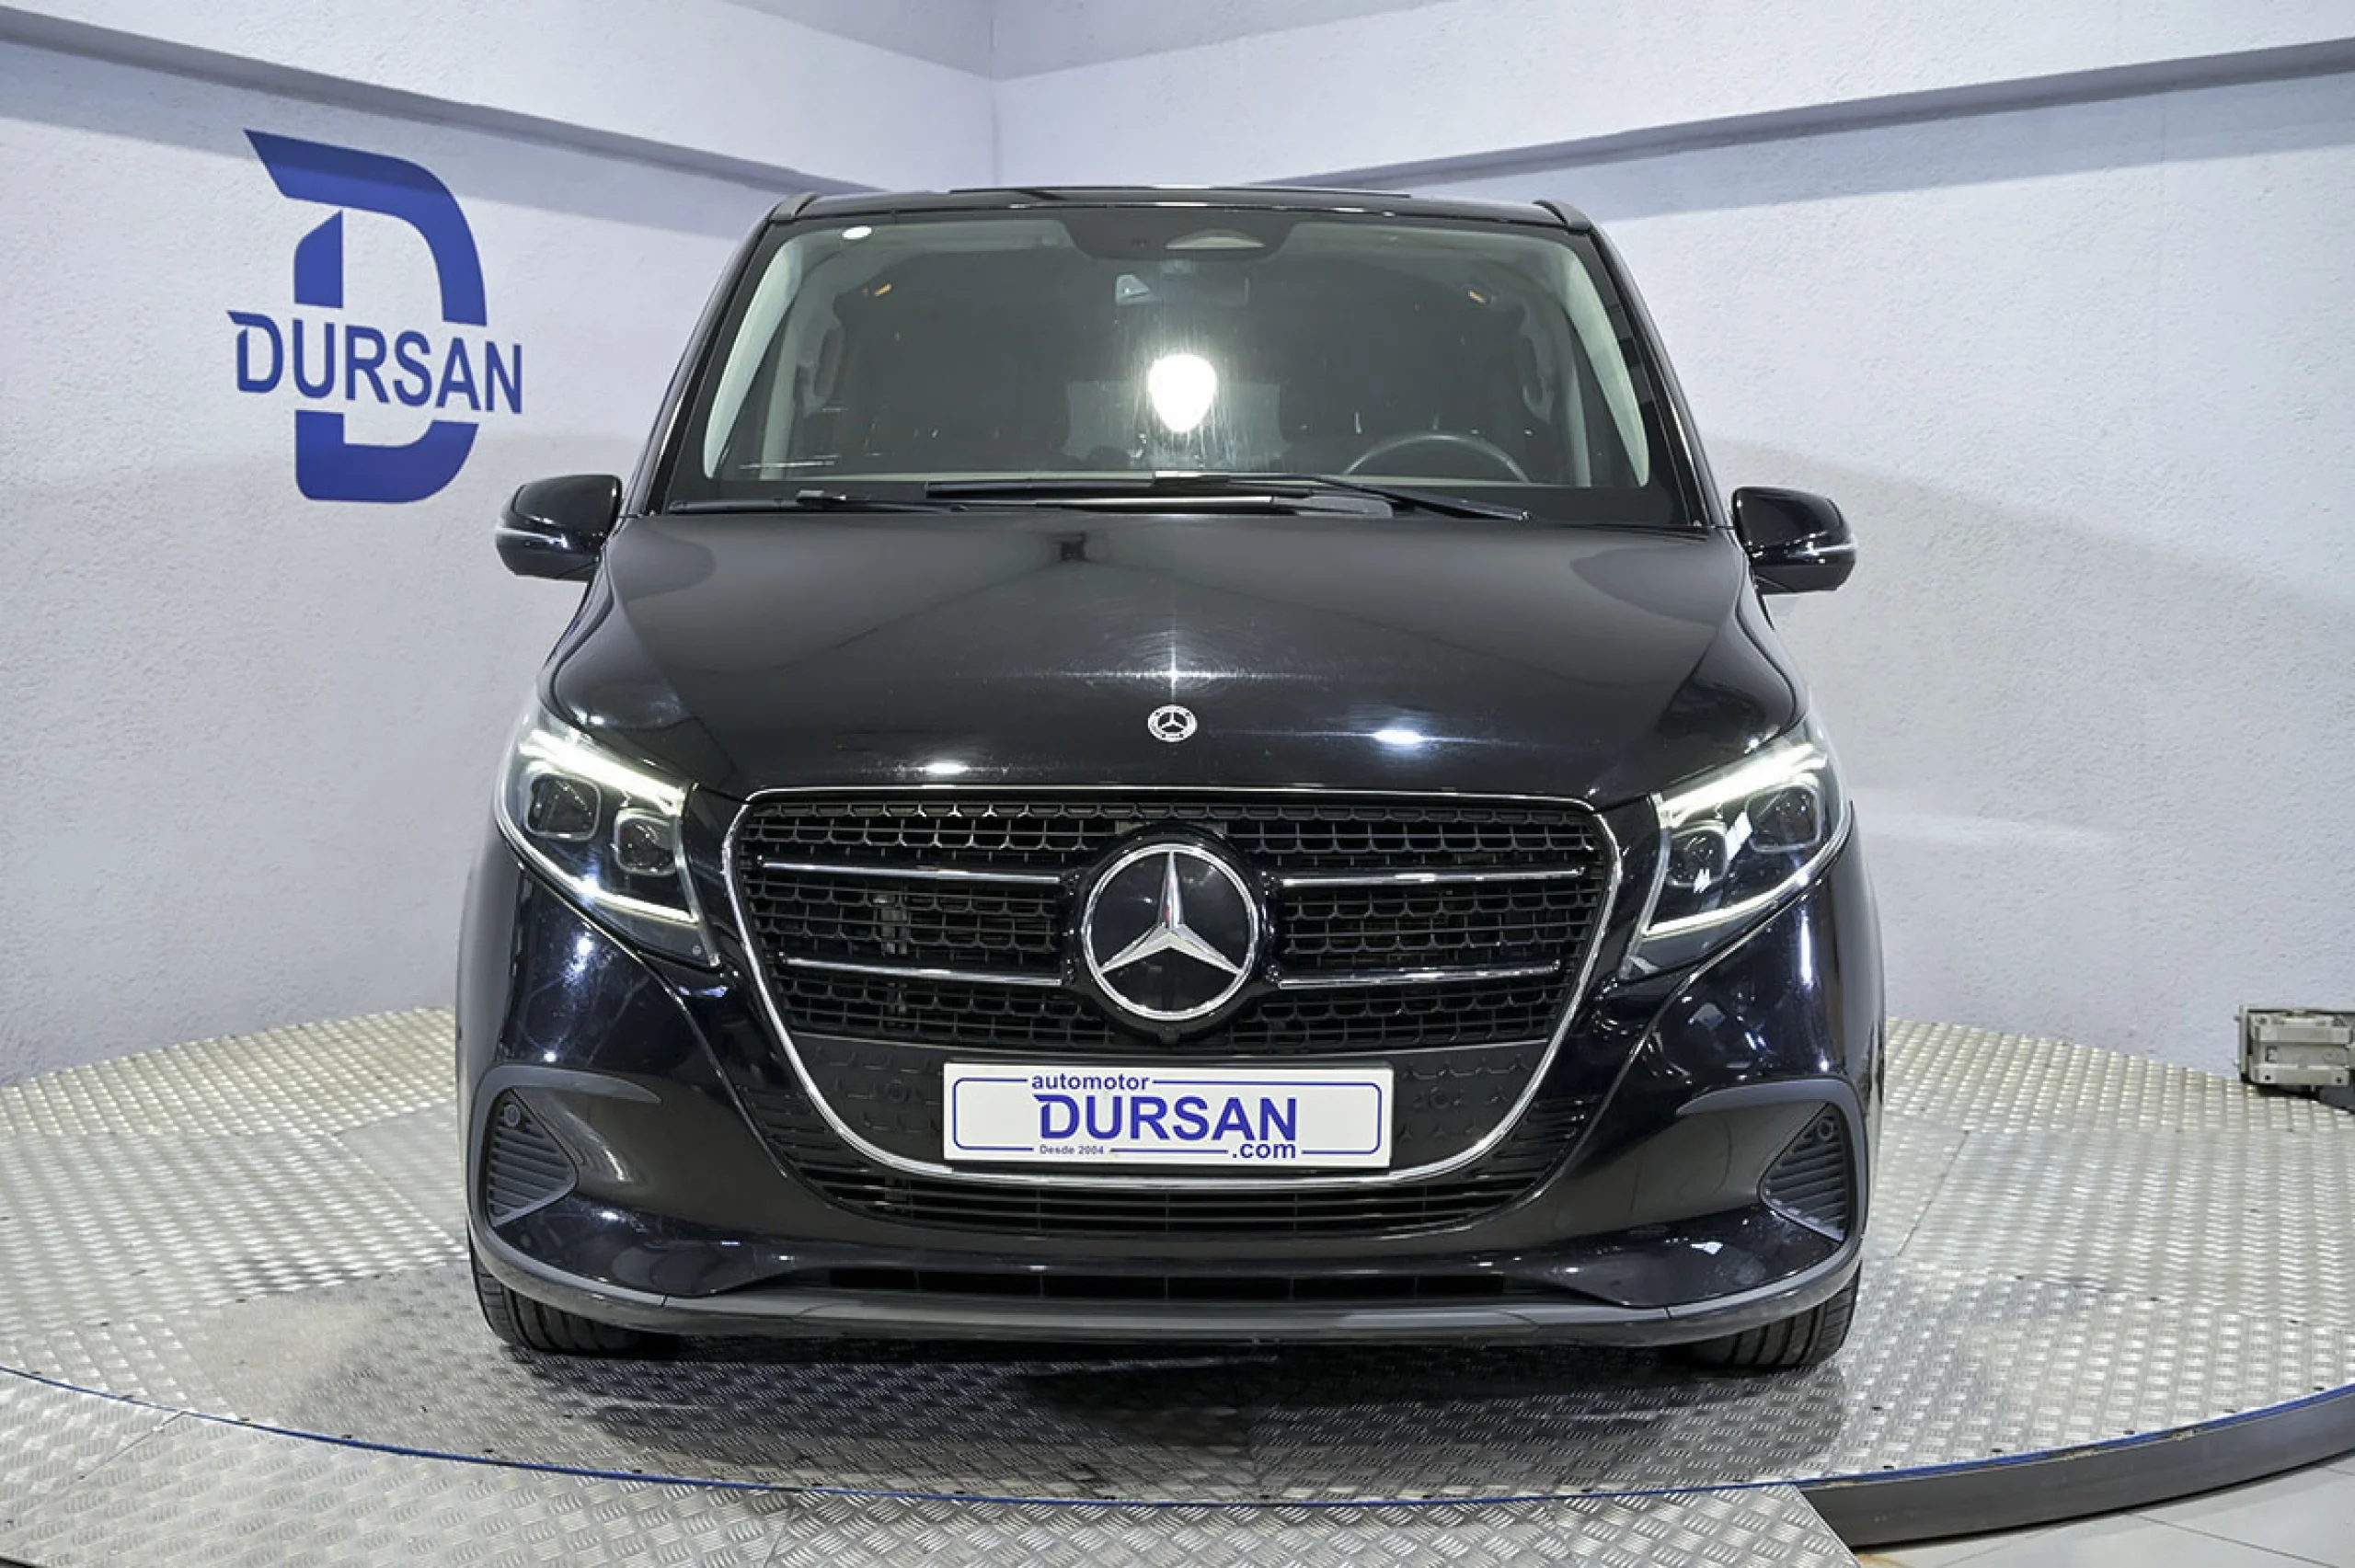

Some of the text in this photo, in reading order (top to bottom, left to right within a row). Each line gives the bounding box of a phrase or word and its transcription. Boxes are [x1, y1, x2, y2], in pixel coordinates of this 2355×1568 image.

[226, 309, 523, 415] DURSAN
[1031, 1072, 1149, 1091] automotor
[1033, 1093, 1297, 1141] DURSAN
[1040, 1144, 1104, 1155] Desde 2004
[1232, 1140, 1296, 1159] .com
